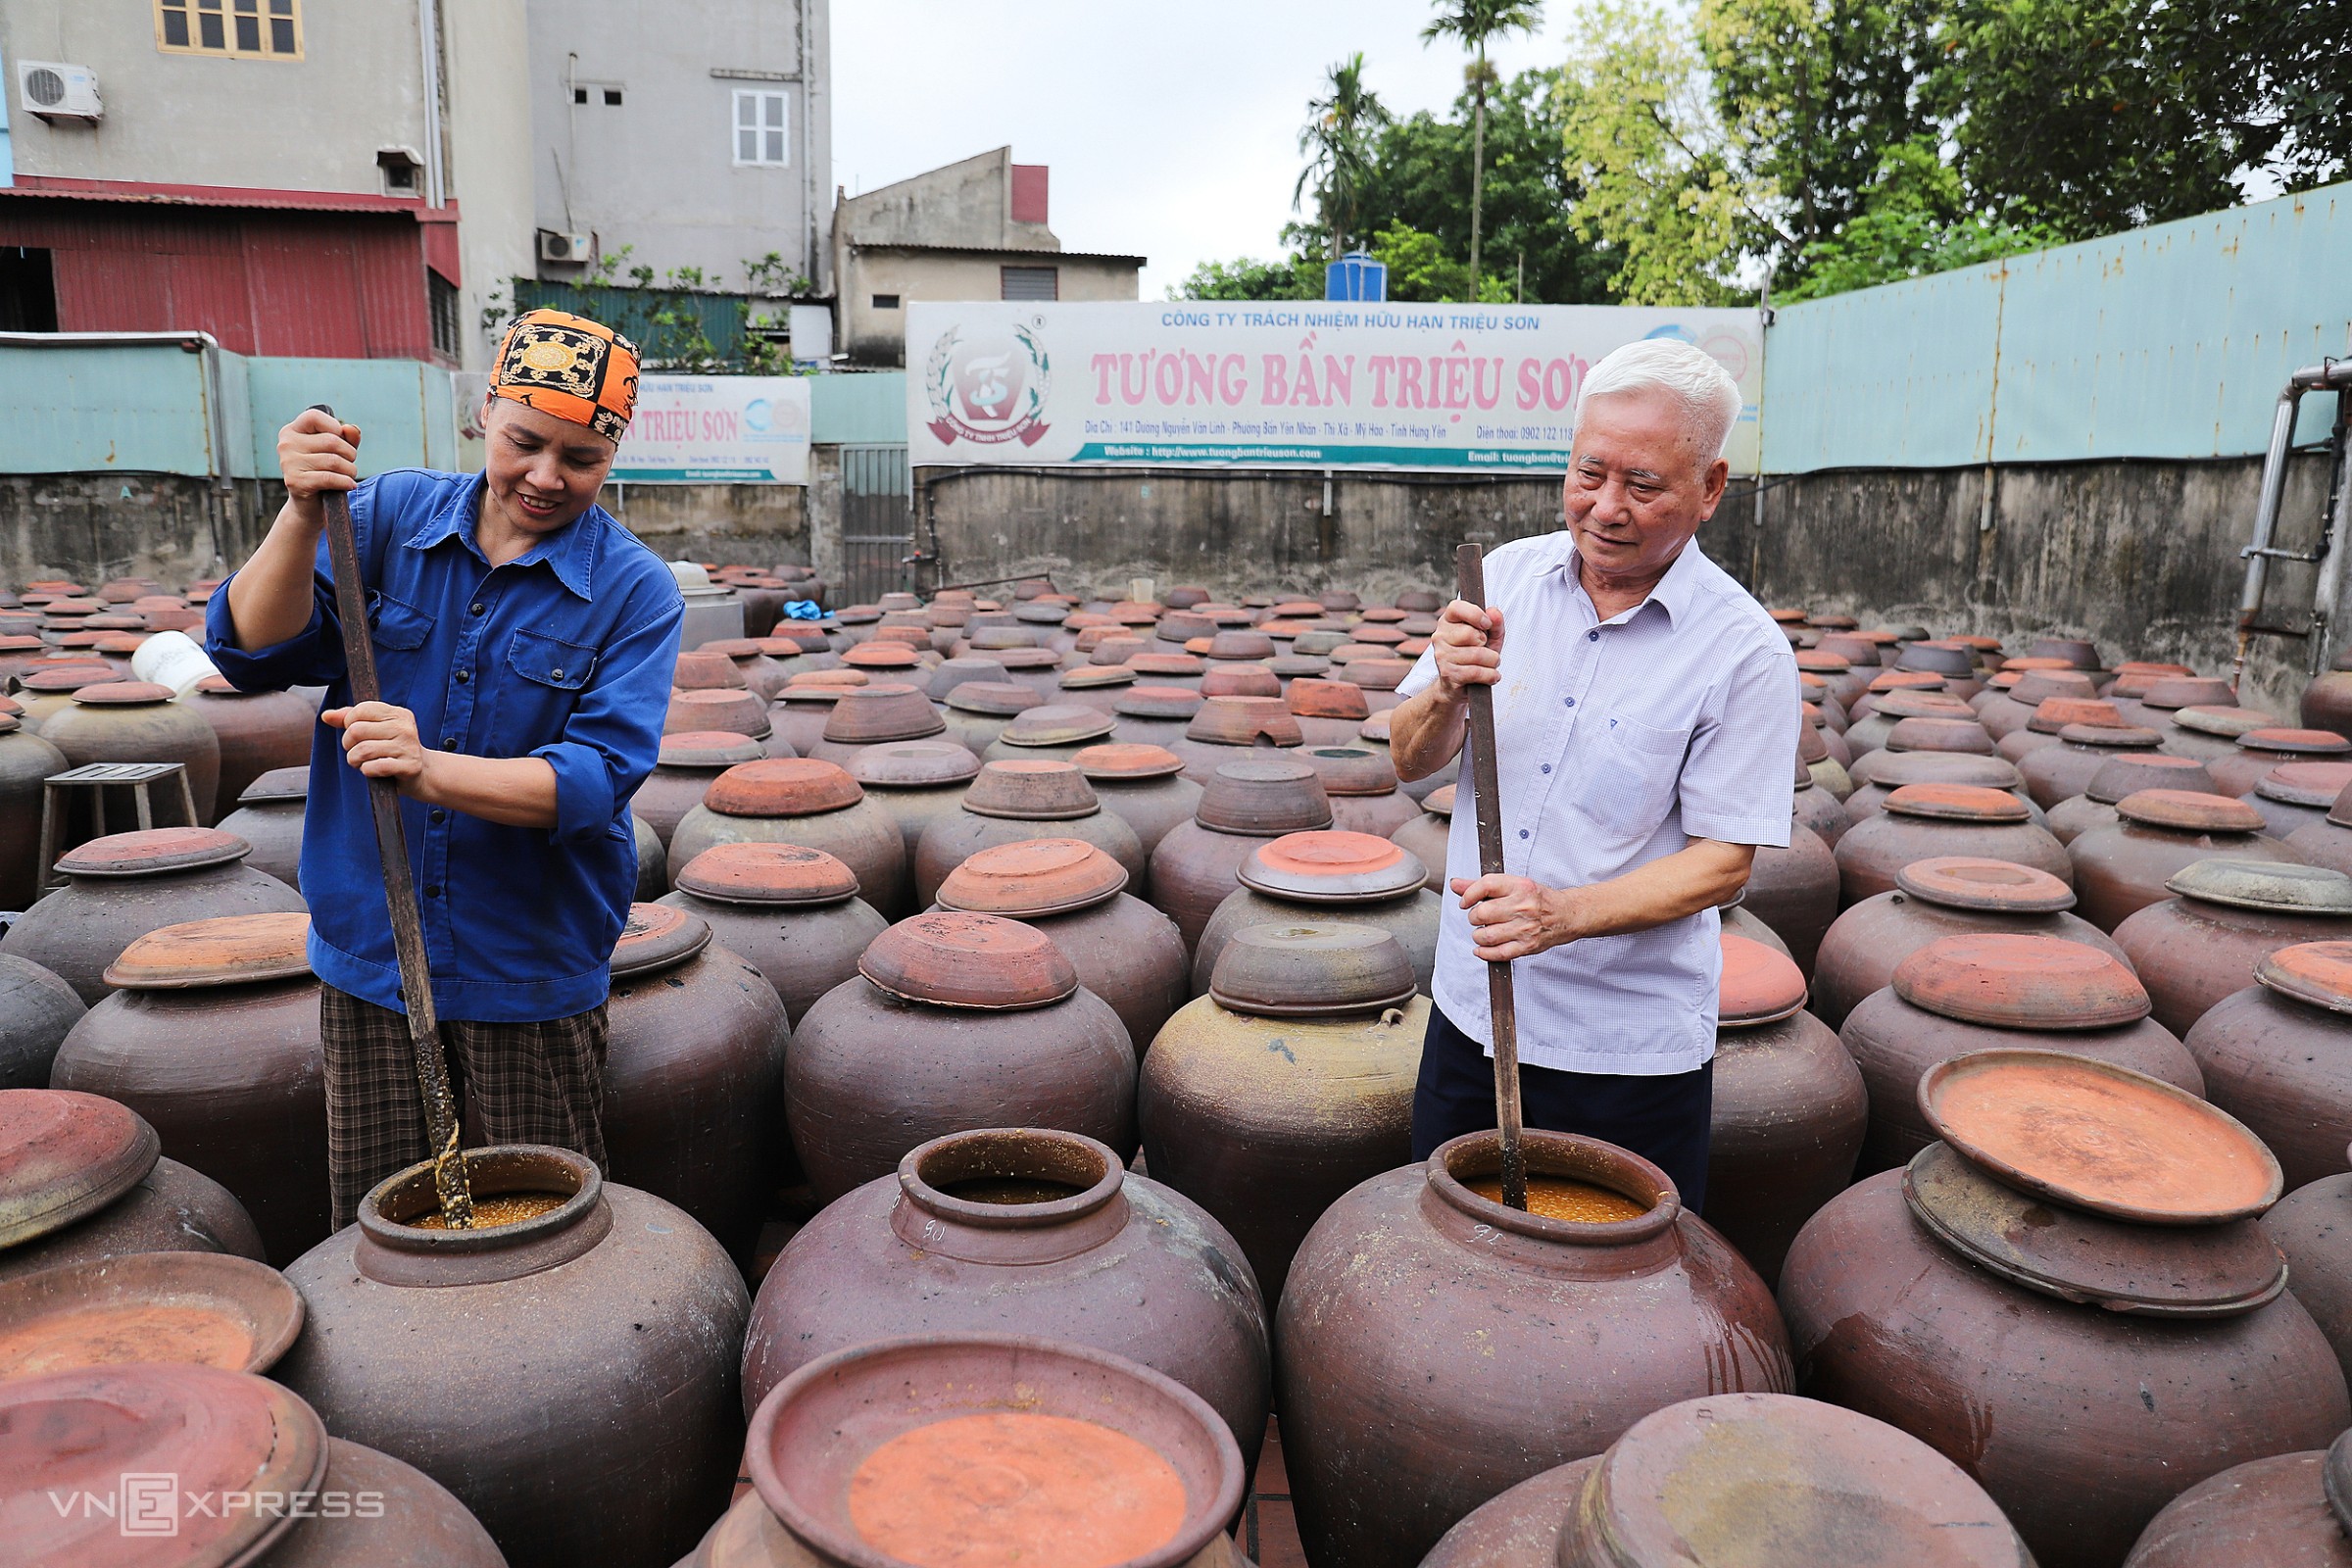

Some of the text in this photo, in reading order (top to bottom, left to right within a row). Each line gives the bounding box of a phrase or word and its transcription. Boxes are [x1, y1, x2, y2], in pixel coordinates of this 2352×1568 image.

[1161, 309, 1541, 334] CÔNG TY TRÁCH NHIỆM HỮU HẠN TRIỆU SƠN
[1091, 347, 1249, 407] TƯƠNG
[1260, 330, 1356, 408] BẦN
[1367, 339, 1504, 423] TRIỆU
[642, 400, 697, 449] TRIỆU
[702, 408, 738, 442] SƠN
[1120, 420, 1133, 434] 141
[1520, 425, 1540, 440] 0902
[1543, 426, 1556, 440] 122
[1103, 445, 1145, 457] Website
[1152, 445, 1322, 460] http://www.tuongbantrieuson.com
[1467, 450, 1499, 463] Email:
